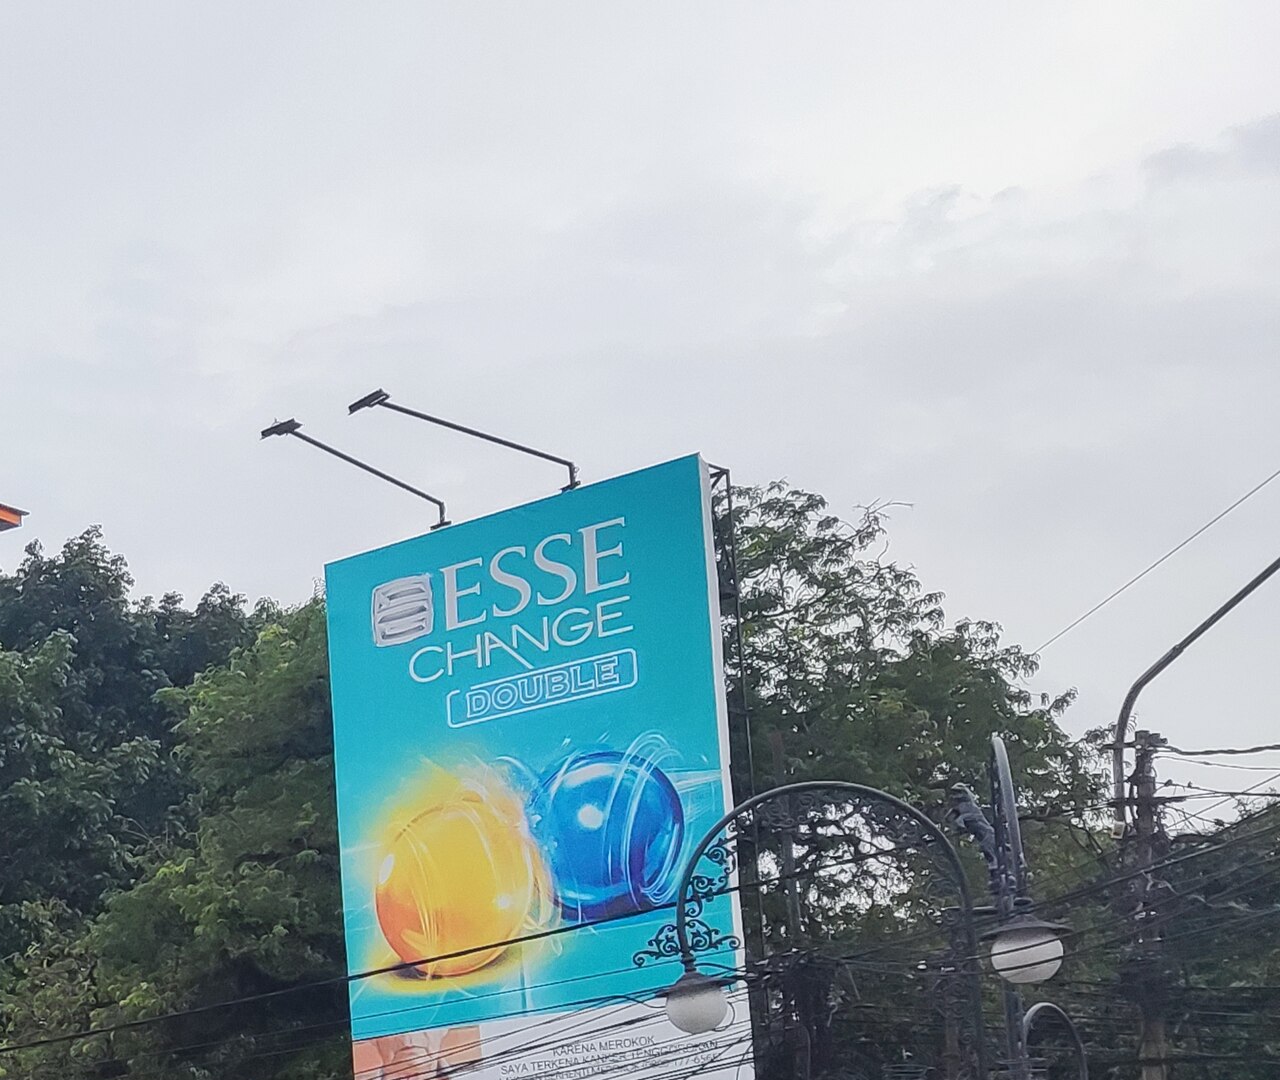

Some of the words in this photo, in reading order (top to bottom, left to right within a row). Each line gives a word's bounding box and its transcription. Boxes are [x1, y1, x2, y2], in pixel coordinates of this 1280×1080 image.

[439, 516, 631, 632] ESSE
[408, 595, 634, 683] CHANGE
[465, 656, 620, 718] DOUBLE
[500, 1062, 529, 1075] SAYA
[552, 1041, 597, 1057] KARENA
[599, 1035, 655, 1051] MEROKOK
